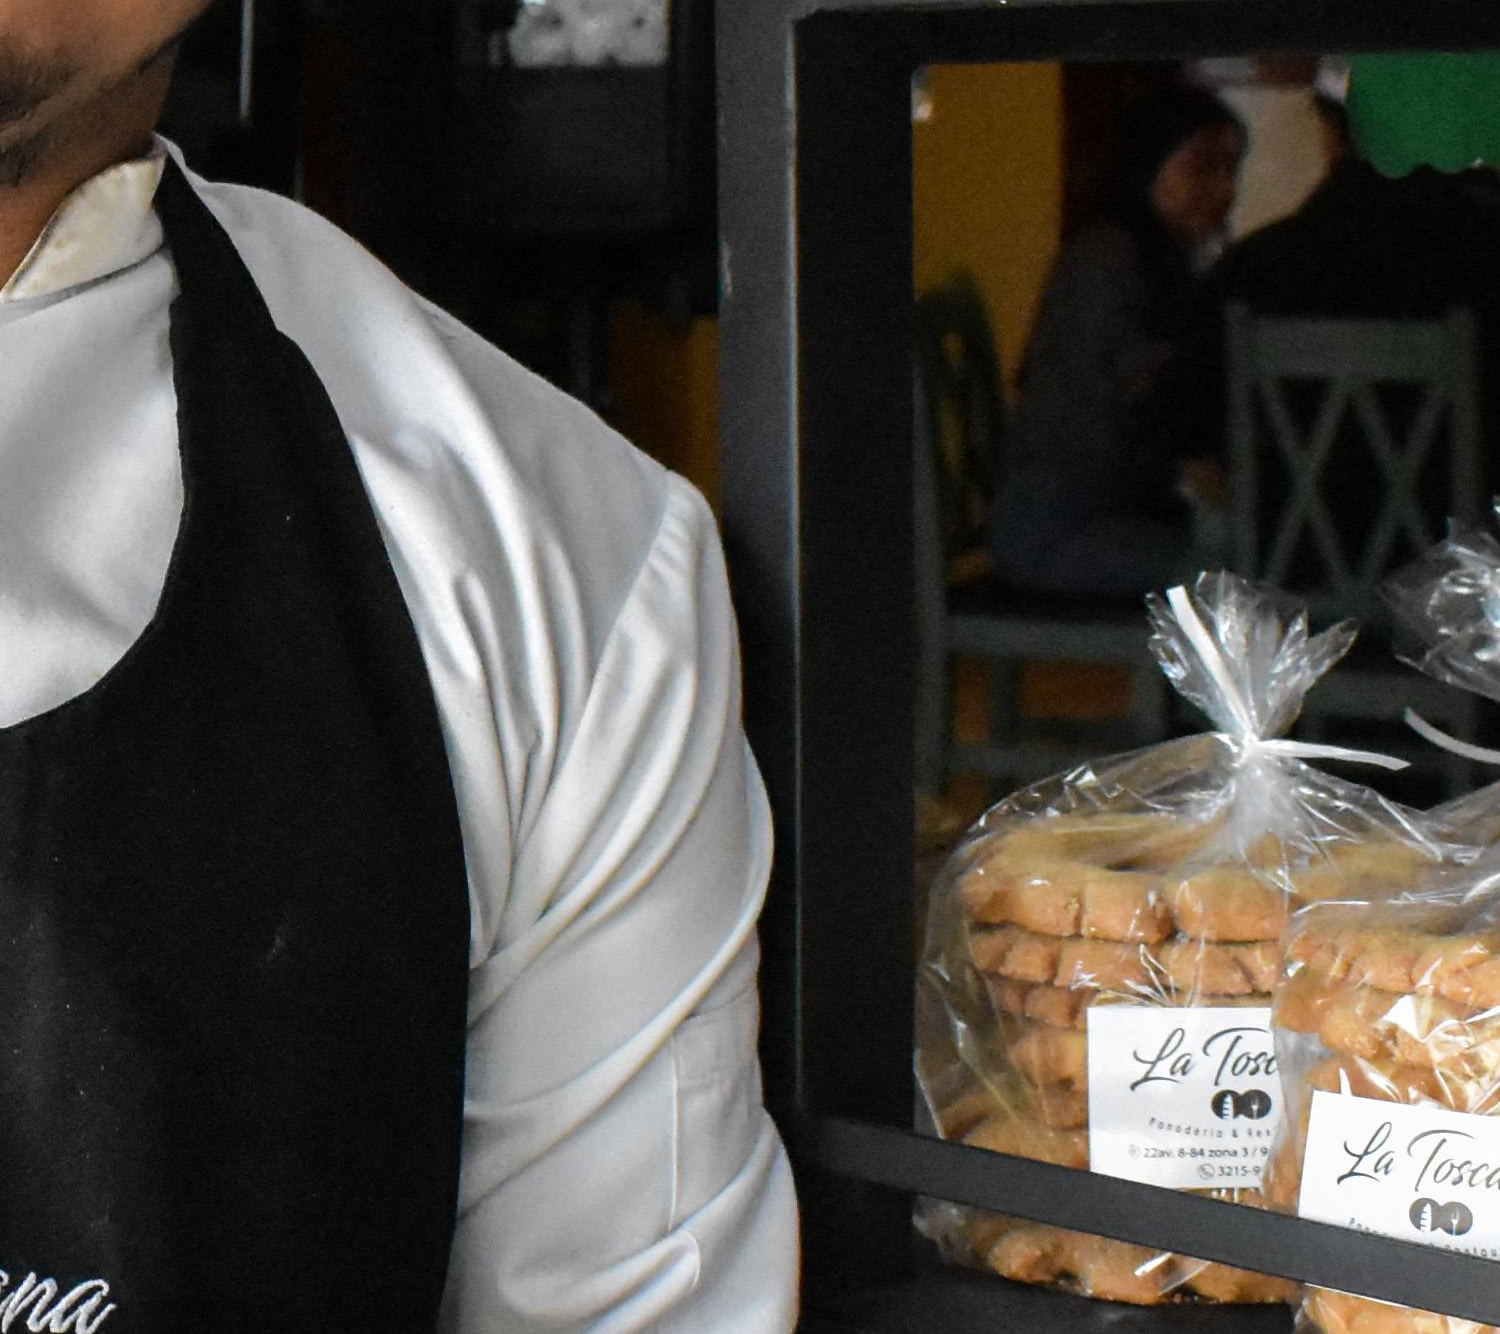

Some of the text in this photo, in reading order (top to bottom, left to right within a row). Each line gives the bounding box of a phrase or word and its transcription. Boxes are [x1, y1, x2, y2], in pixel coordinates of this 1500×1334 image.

[1130, 1026, 1278, 1092] La Tosc
[1208, 1148, 1238, 1158] zona
[1241, 1147, 1249, 1158] 3
[1336, 1121, 1400, 1186] La
